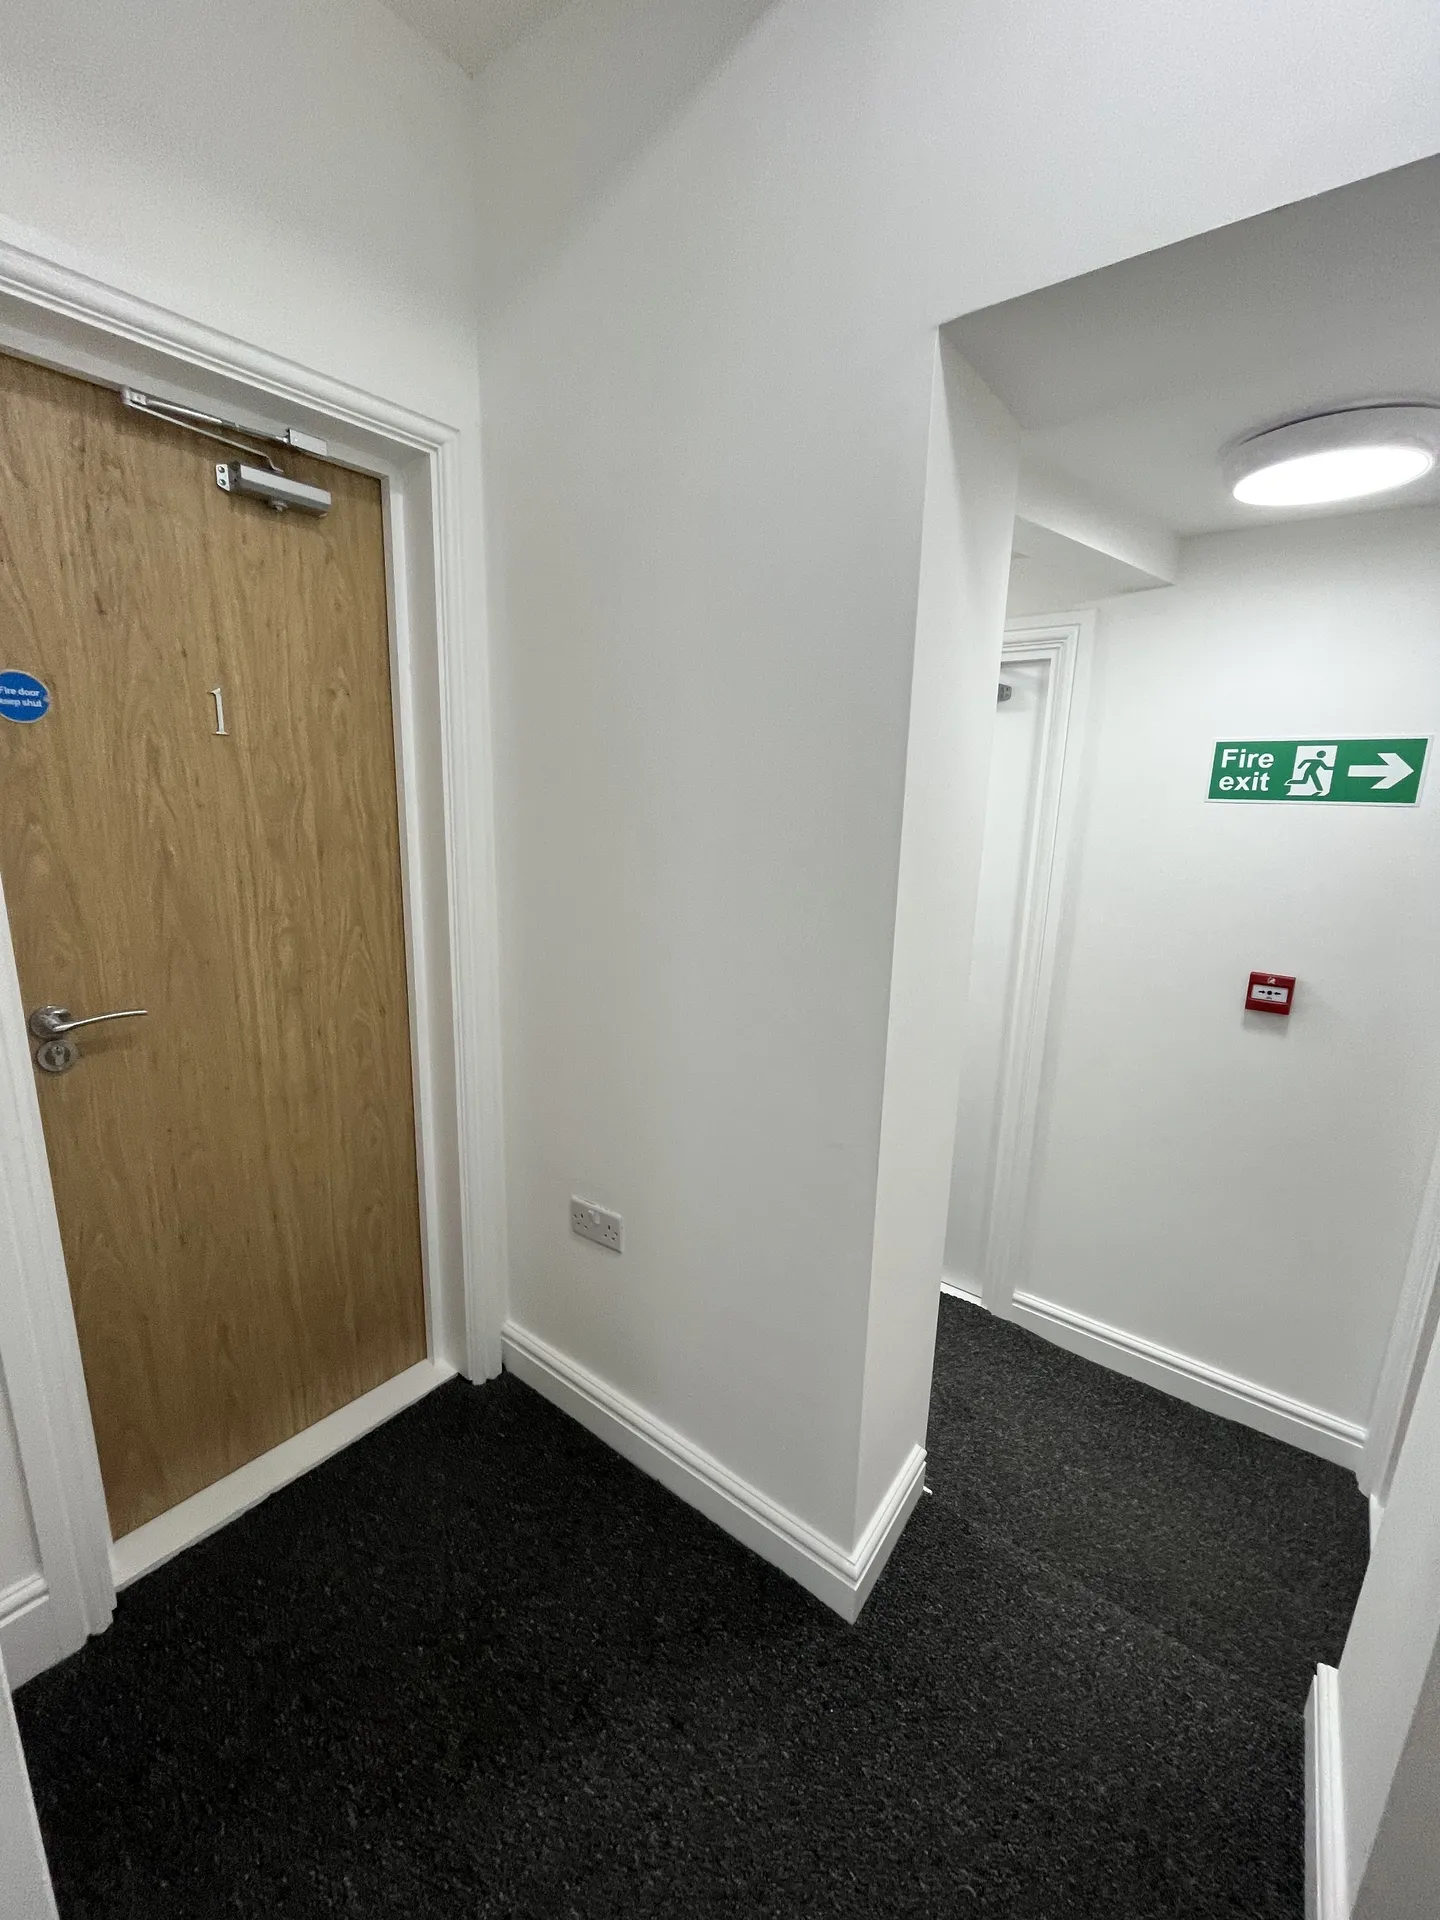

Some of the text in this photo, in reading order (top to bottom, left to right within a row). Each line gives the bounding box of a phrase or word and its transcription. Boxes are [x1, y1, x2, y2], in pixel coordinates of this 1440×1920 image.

[18, 688, 40, 696] door
[22, 699, 42, 708] shut
[208, 688, 229, 736] 1
[1221, 749, 1274, 768] Fire
[1219, 772, 1270, 791] exit
